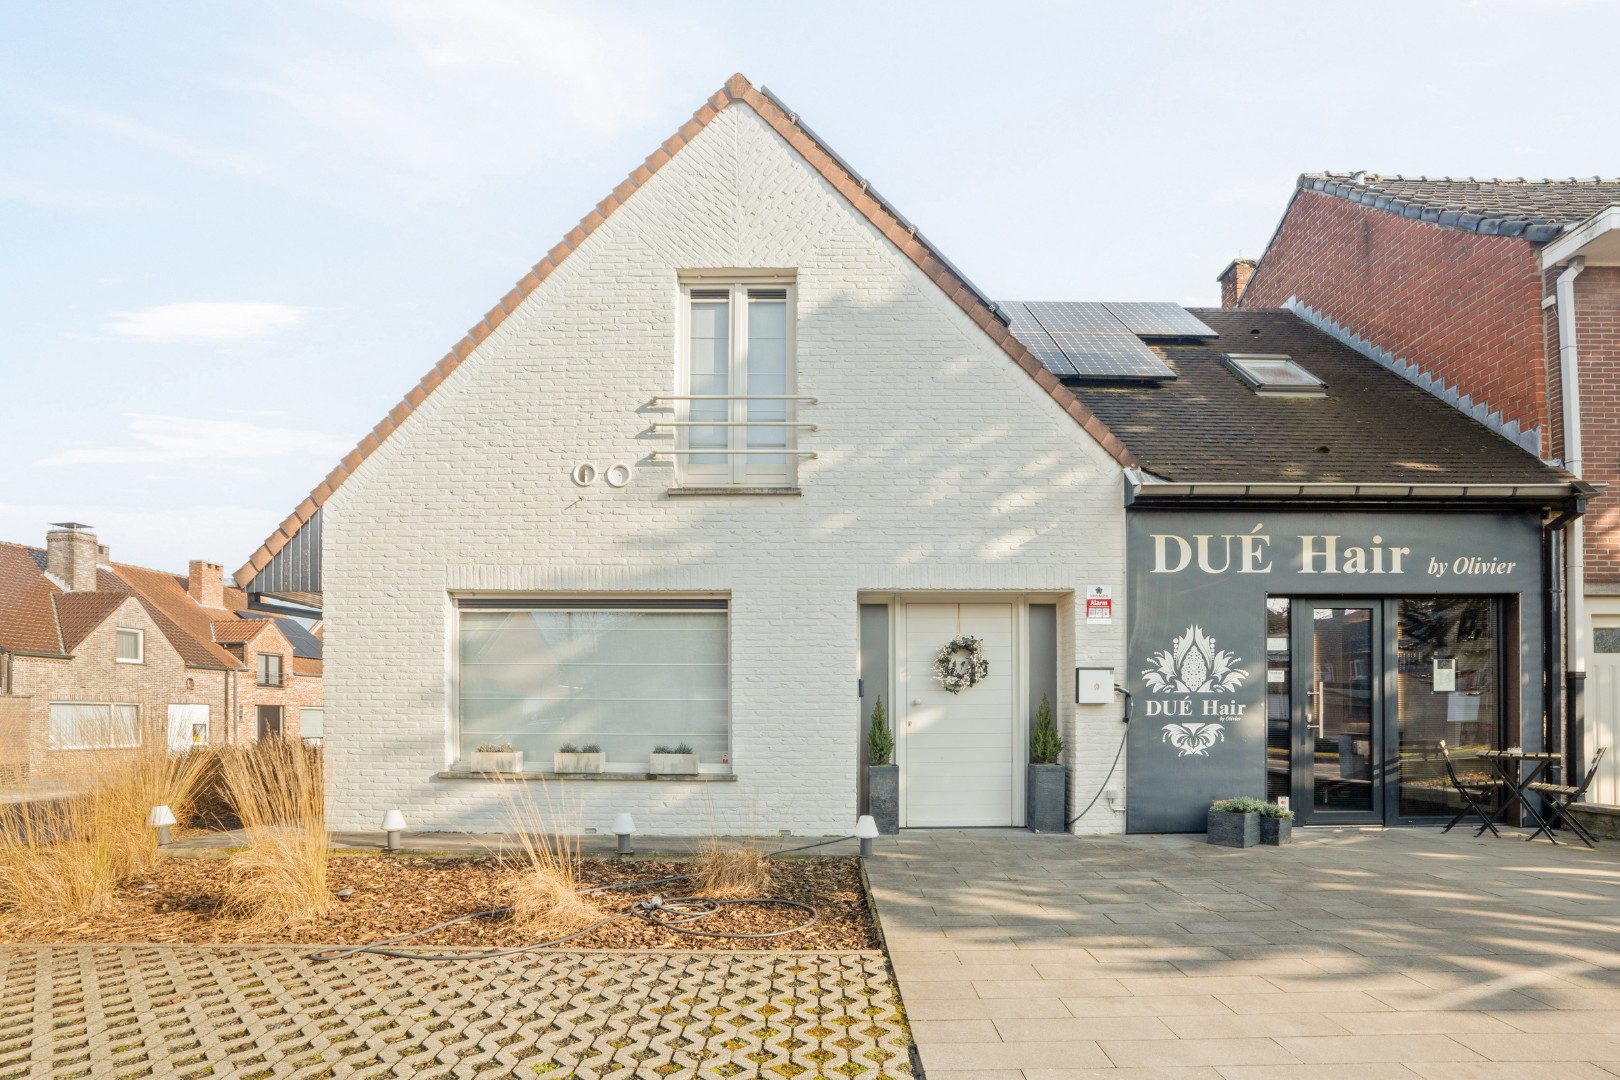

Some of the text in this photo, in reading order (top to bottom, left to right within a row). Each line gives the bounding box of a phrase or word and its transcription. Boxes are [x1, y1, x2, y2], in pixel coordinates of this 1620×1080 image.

[1150, 523, 1517, 577] DUÉ Hair by Olivier
[1145, 695, 1246, 716] DUÉ Hair
